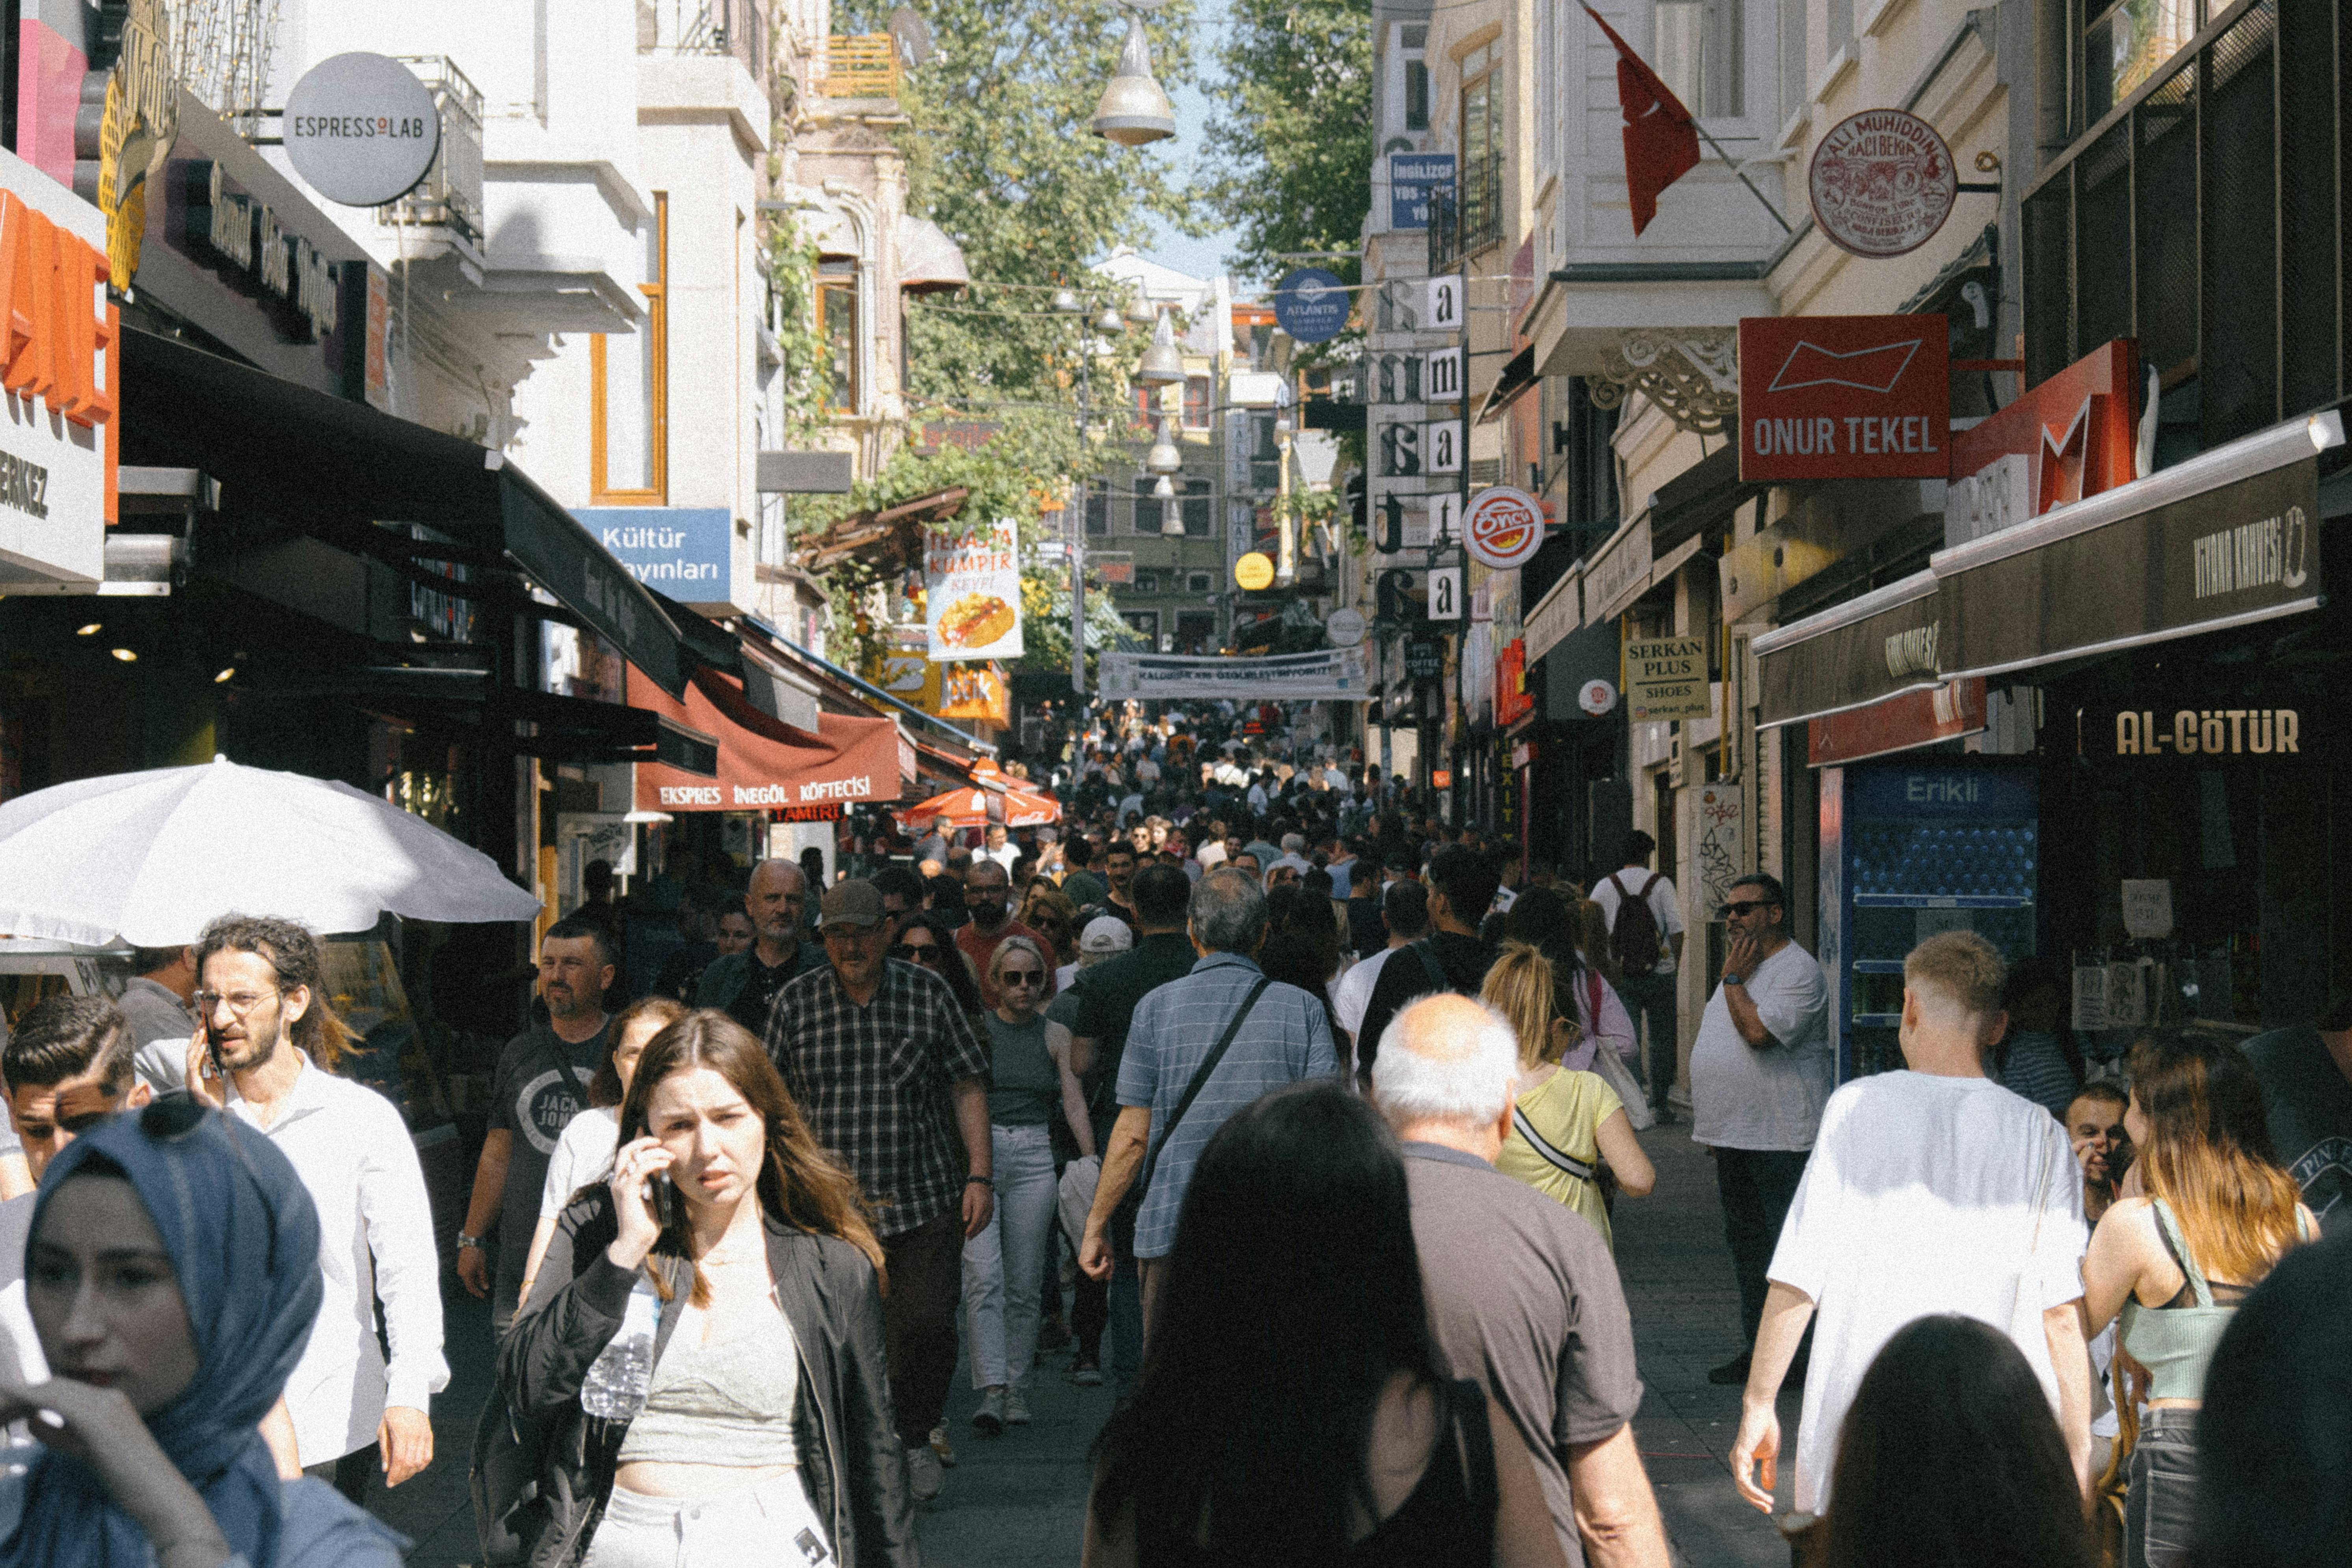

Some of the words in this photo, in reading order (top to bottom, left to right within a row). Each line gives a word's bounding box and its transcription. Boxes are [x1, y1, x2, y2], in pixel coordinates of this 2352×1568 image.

[295, 117, 422, 138] ESPRESSOLAB
[1754, 418, 1835, 456] ONUR
[1849, 416, 1938, 454] TEKEL
[0, 449, 49, 521] ERKEZ
[603, 526, 686, 550] Kültür
[620, 558, 718, 582] ayınları
[1628, 640, 1703, 659] SERKAN
[1644, 660, 1691, 676] PLUS
[947, 672, 992, 708] ptik
[1646, 685, 1692, 698] SHOES
[659, 787, 722, 805] EKSPRES
[733, 784, 789, 804] İNEGÖL
[800, 775, 871, 802] KÖFTECİSİ
[1906, 776, 1979, 803] Erikli
[538, 1094, 580, 1113] JACK
[538, 1110, 575, 1128] JON
